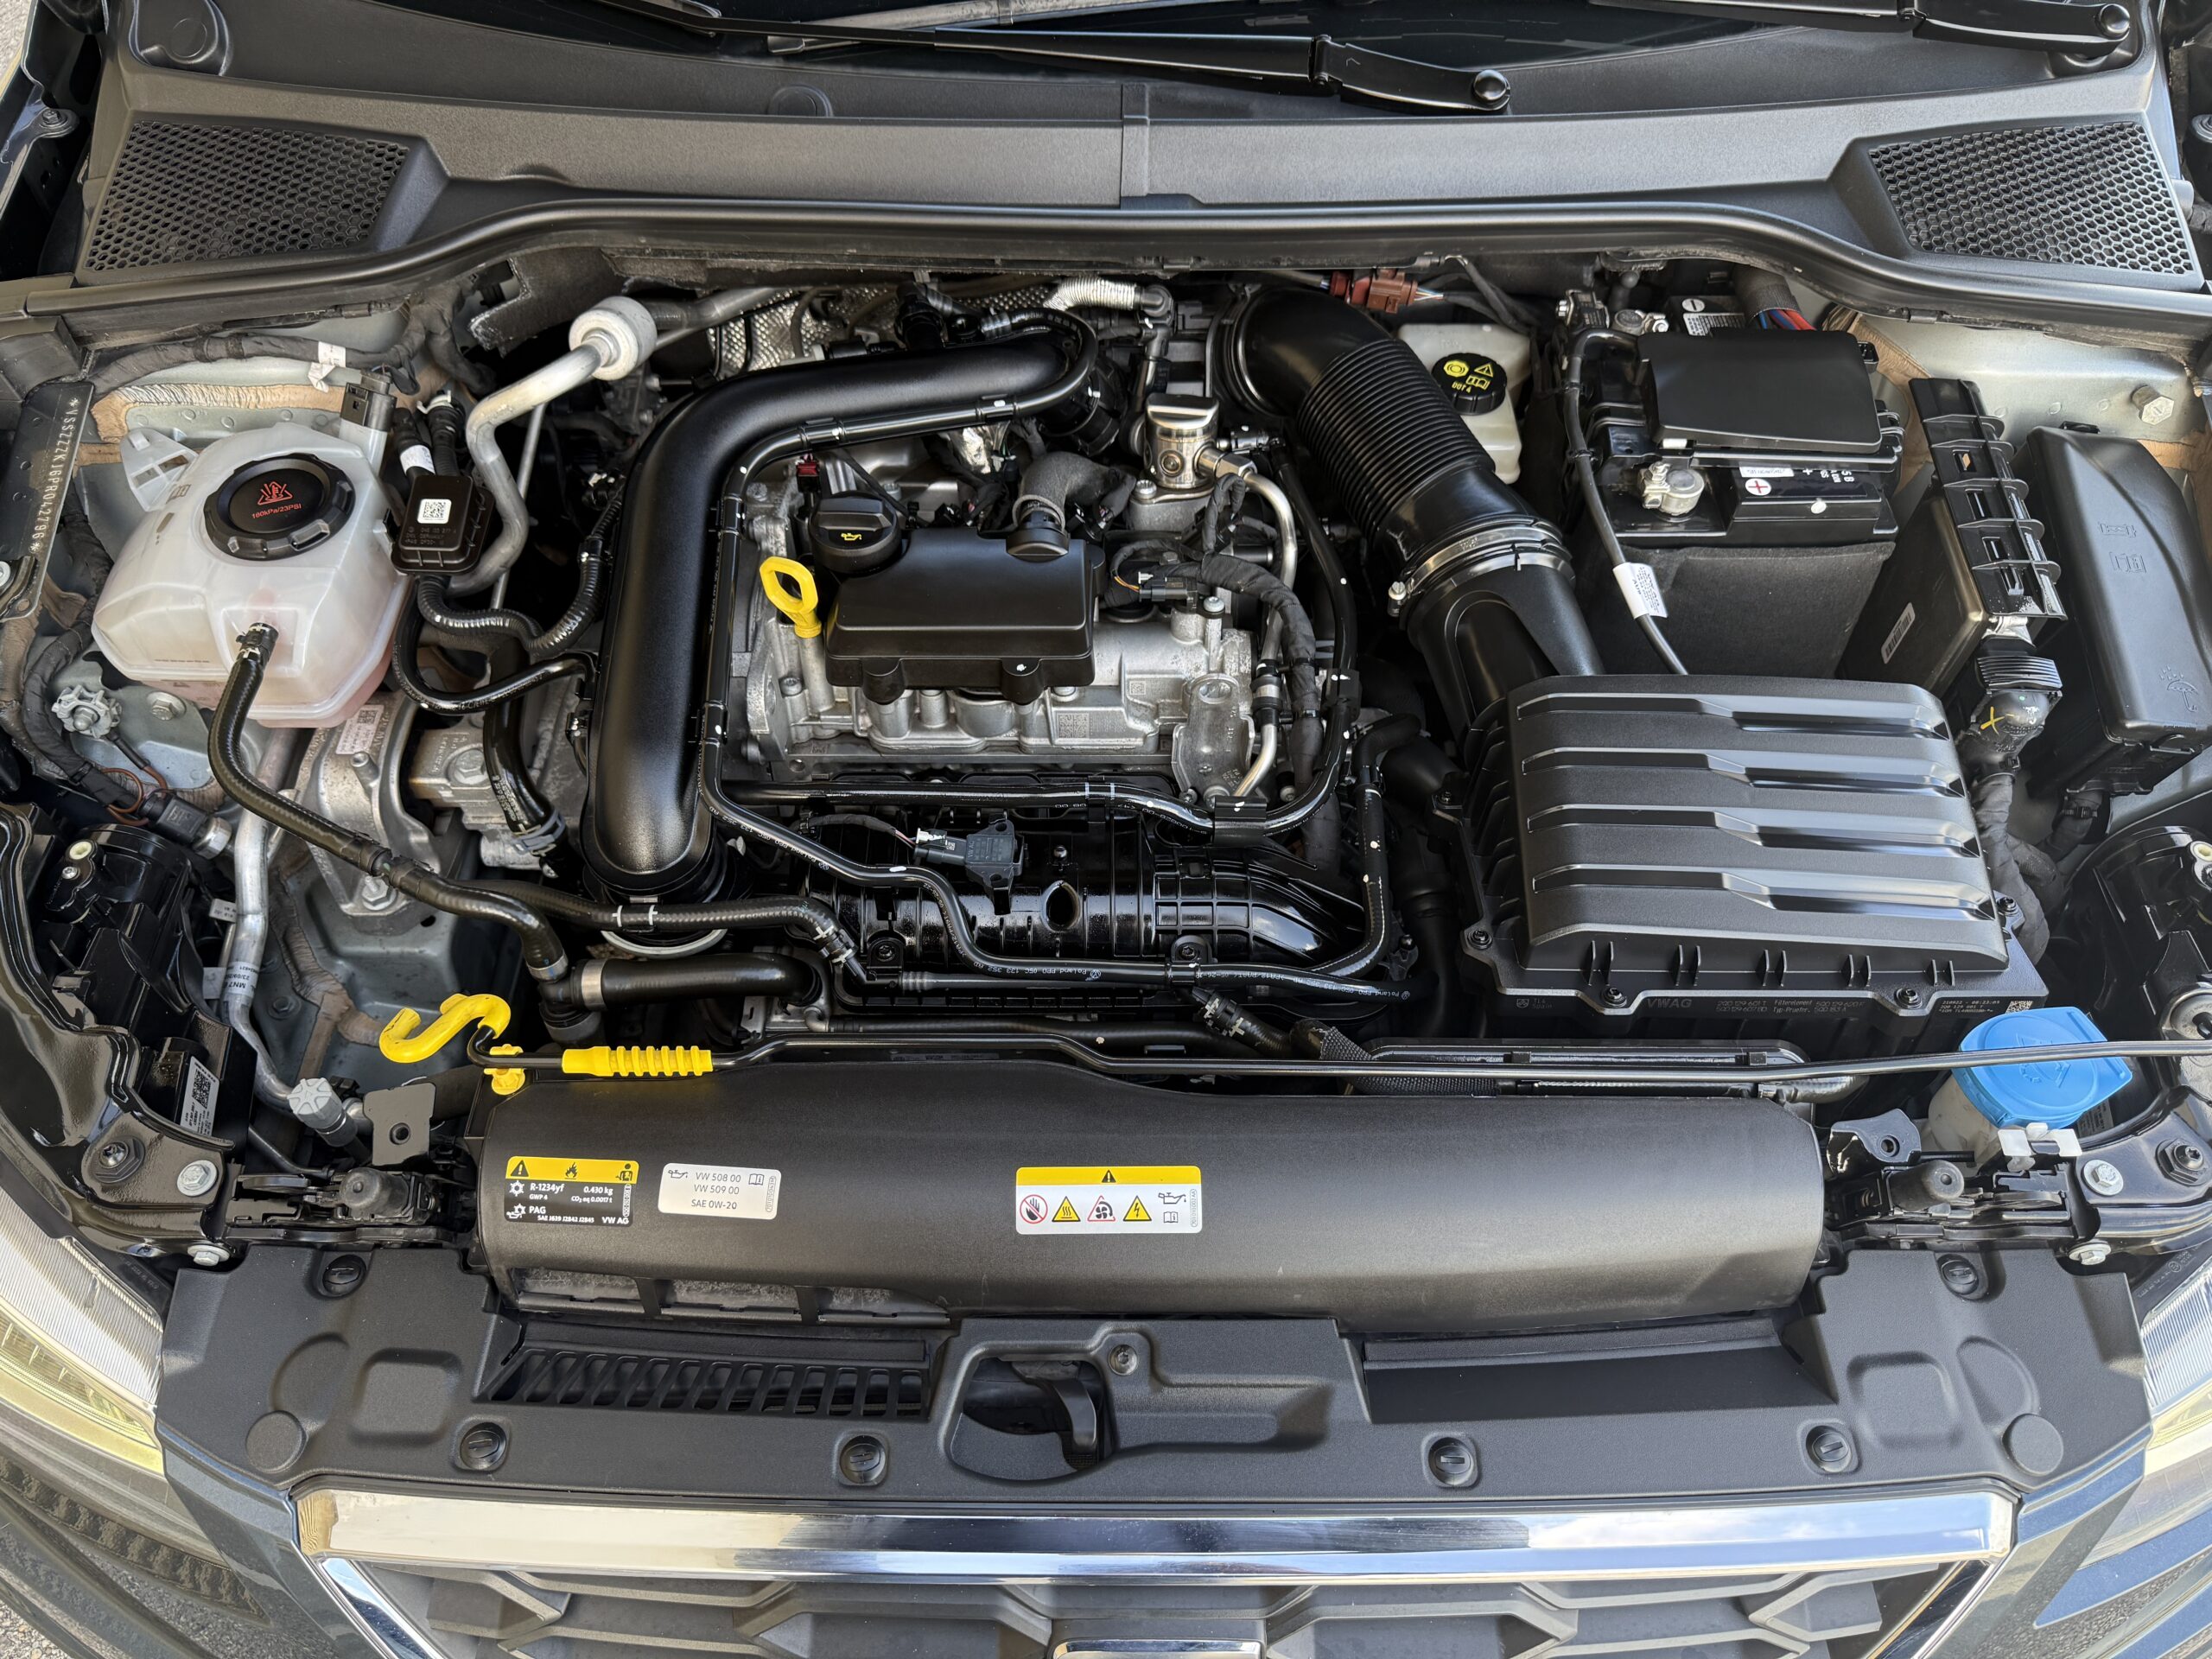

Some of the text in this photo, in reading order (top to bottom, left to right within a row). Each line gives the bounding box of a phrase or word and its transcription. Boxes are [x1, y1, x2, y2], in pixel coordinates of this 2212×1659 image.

[696, 1172, 741, 1183] VW 508 00
[530, 1182, 613, 1196] R-1234yf 0.430 kg
[694, 1184, 740, 1195] VW 509 00
[691, 1198, 737, 1210] SAE 0W-20
[529, 1205, 546, 1215] PAG
